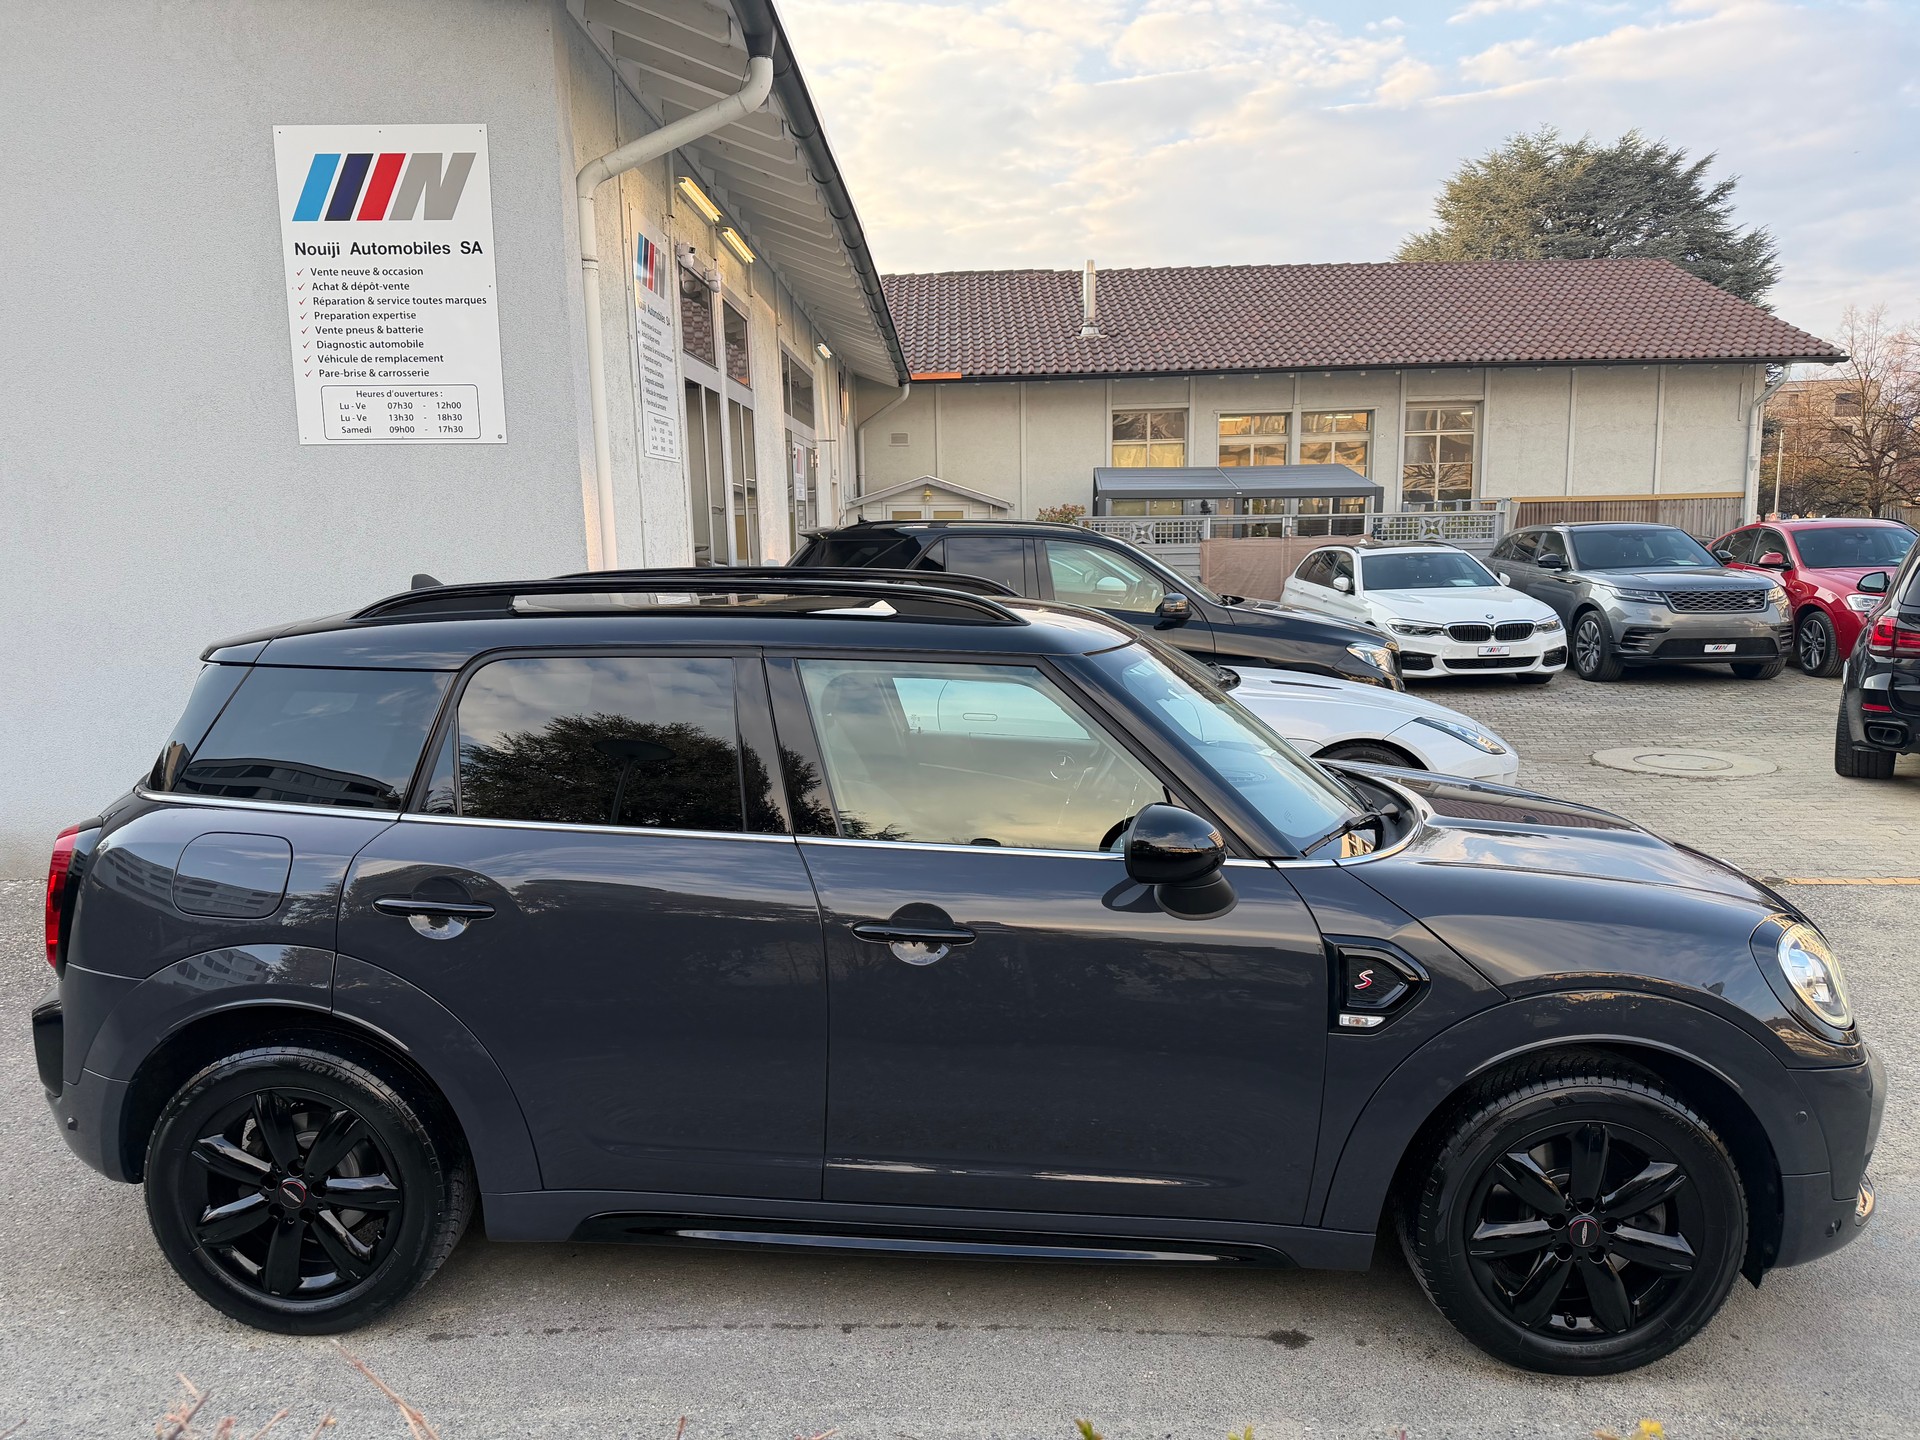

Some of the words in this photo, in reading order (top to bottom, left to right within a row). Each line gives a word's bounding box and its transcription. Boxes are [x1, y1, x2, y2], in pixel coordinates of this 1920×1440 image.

[294, 241, 340, 258] Nouiji
[349, 240, 451, 255] Automobiles
[459, 240, 483, 254] SA
[309, 267, 339, 276] Vente
[340, 268, 370, 276] neuve
[372, 266, 380, 276] &
[381, 266, 424, 276] occasion
[311, 281, 339, 291] Achat
[341, 281, 349, 291] &
[350, 280, 410, 292] dépôt-vente
[312, 295, 365, 307] Réparation
[367, 295, 375, 305] &
[376, 295, 410, 305] service
[411, 296, 443, 305] toutes
[444, 296, 487, 306] marques
[313, 310, 370, 322] Preparation
[371, 310, 416, 322] expertise
[314, 325, 343, 334] Vente
[345, 326, 375, 336] pneus
[376, 324, 384, 334] &
[385, 324, 424, 334] batterie
[316, 339, 367, 351] Diagnostic
[368, 338, 424, 348] automobile
[316, 353, 358, 363] Véhicule
[360, 353, 373, 363] de
[374, 353, 444, 365] remplacement
[318, 368, 367, 378] Pare-brise
[368, 367, 376, 377] &
[377, 367, 430, 377] carrosserie
[355, 389, 385, 398] Heures
[339, 402, 349, 410] Lu
[355, 401, 366, 410] Ve
[387, 401, 413, 409] 07h30
[436, 400, 462, 409] 12h00
[340, 414, 350, 422] Lu
[356, 413, 367, 422] Ve
[388, 413, 414, 421] 13h30
[437, 412, 463, 421] 18h30
[341, 425, 372, 434] Samedi
[388, 425, 415, 434] 09h00
[438, 424, 464, 433] 17h30
[1354, 969, 1374, 990] S
